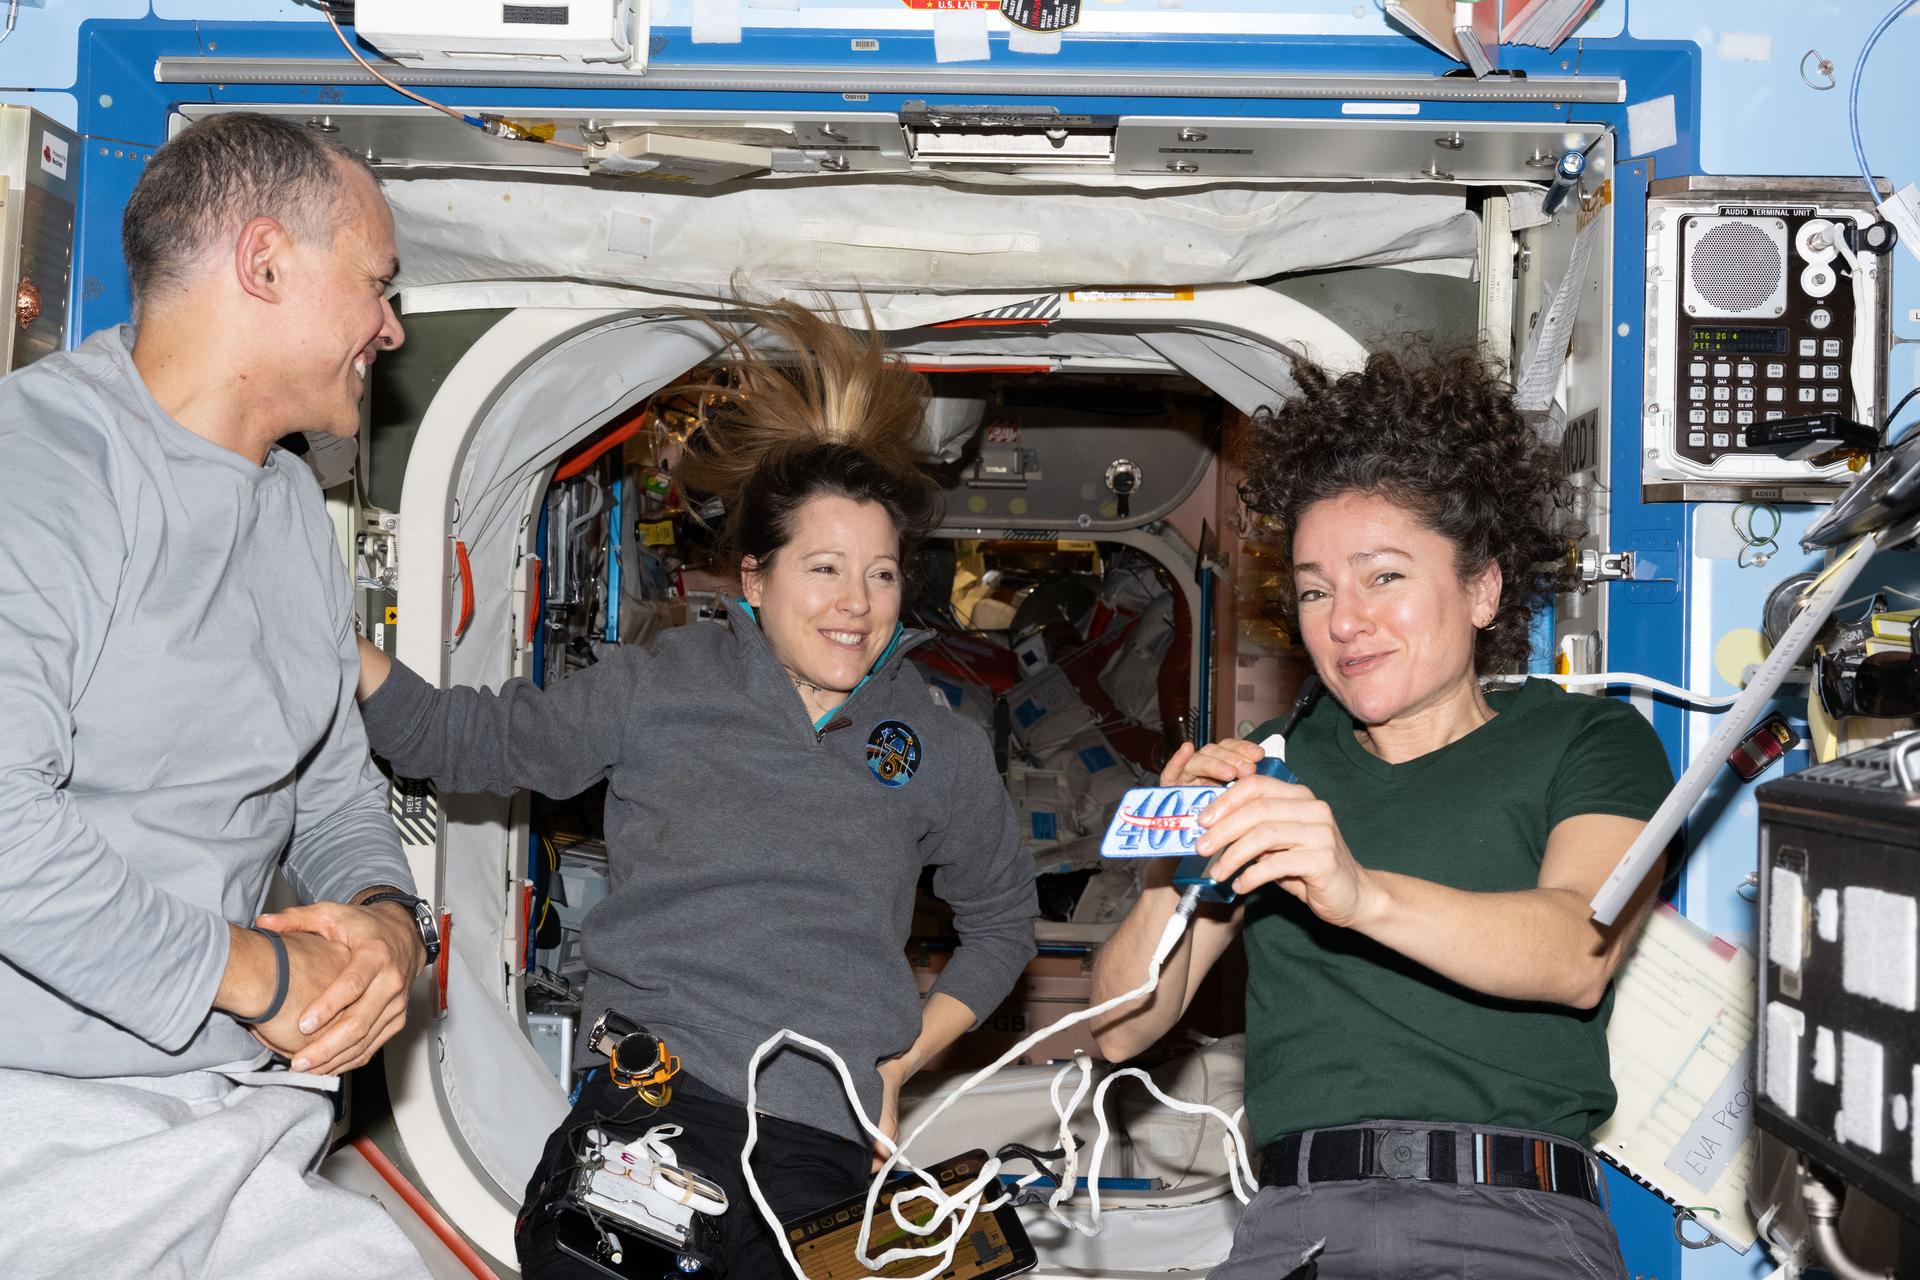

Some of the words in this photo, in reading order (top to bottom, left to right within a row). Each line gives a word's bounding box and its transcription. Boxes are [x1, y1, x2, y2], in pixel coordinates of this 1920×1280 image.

[938, 1, 956, 9] U.S.
[958, 0, 978, 9] LAB
[1591, 413, 1596, 464] 1
[1846, 630, 1864, 642] 3M
[1116, 790, 1216, 850] 400
[1150, 818, 1180, 828] DAYS
[1684, 1136, 1722, 1176] EVA
